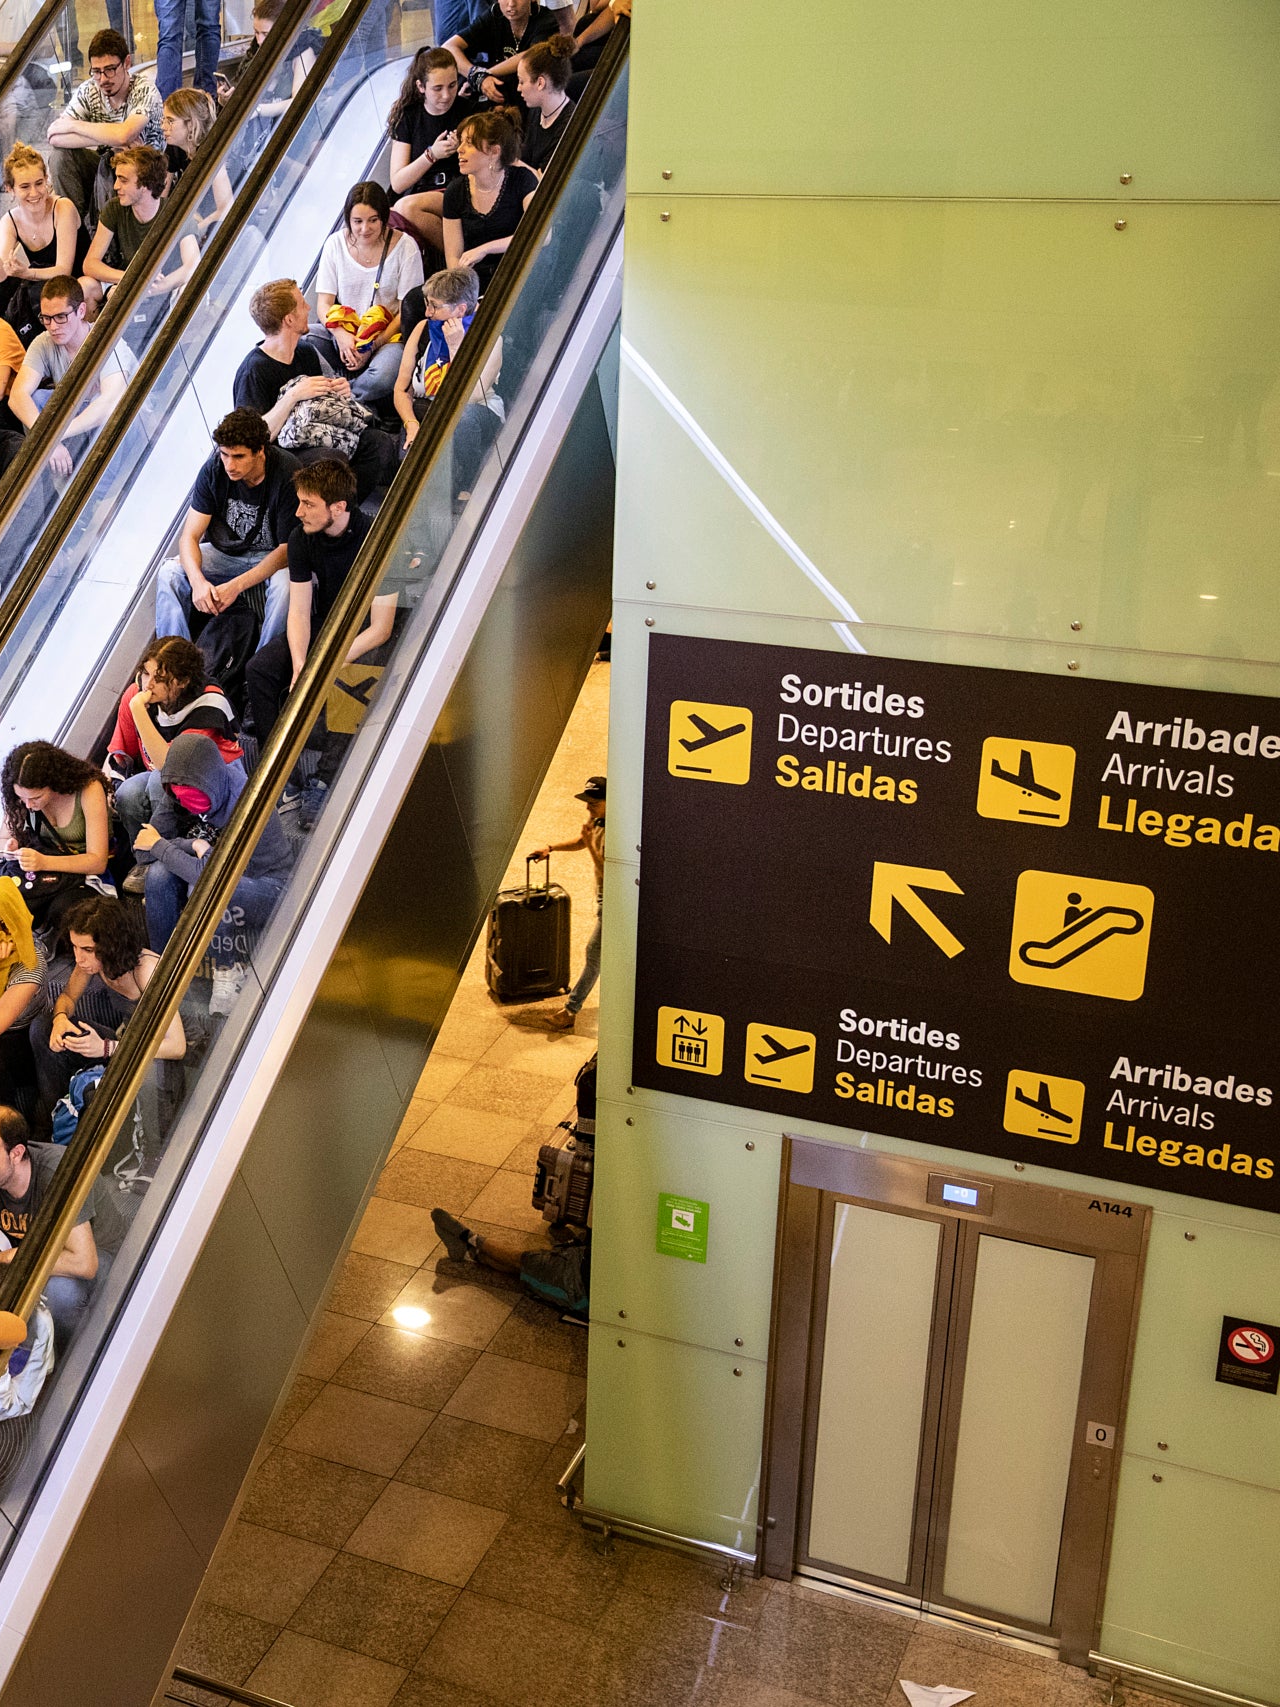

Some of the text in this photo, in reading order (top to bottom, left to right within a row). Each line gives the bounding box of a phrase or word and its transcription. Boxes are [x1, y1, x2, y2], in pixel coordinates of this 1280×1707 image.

[780, 673, 925, 719] Sortides
[778, 713, 952, 763] Departures
[1106, 711, 1280, 759] Arribade
[775, 755, 919, 805] Salidas
[1101, 753, 1235, 798] Arrivals
[1098, 795, 1280, 853] Llegada
[839, 1009, 961, 1051] Sortides
[837, 1038, 983, 1088] Departures
[1110, 1057, 1273, 1107] Arribades
[834, 1072, 955, 1118] Salidas
[1106, 1088, 1215, 1131] Arrivals
[1104, 1122, 1275, 1179] Llegadas
[1088, 1200, 1133, 1218] A144
